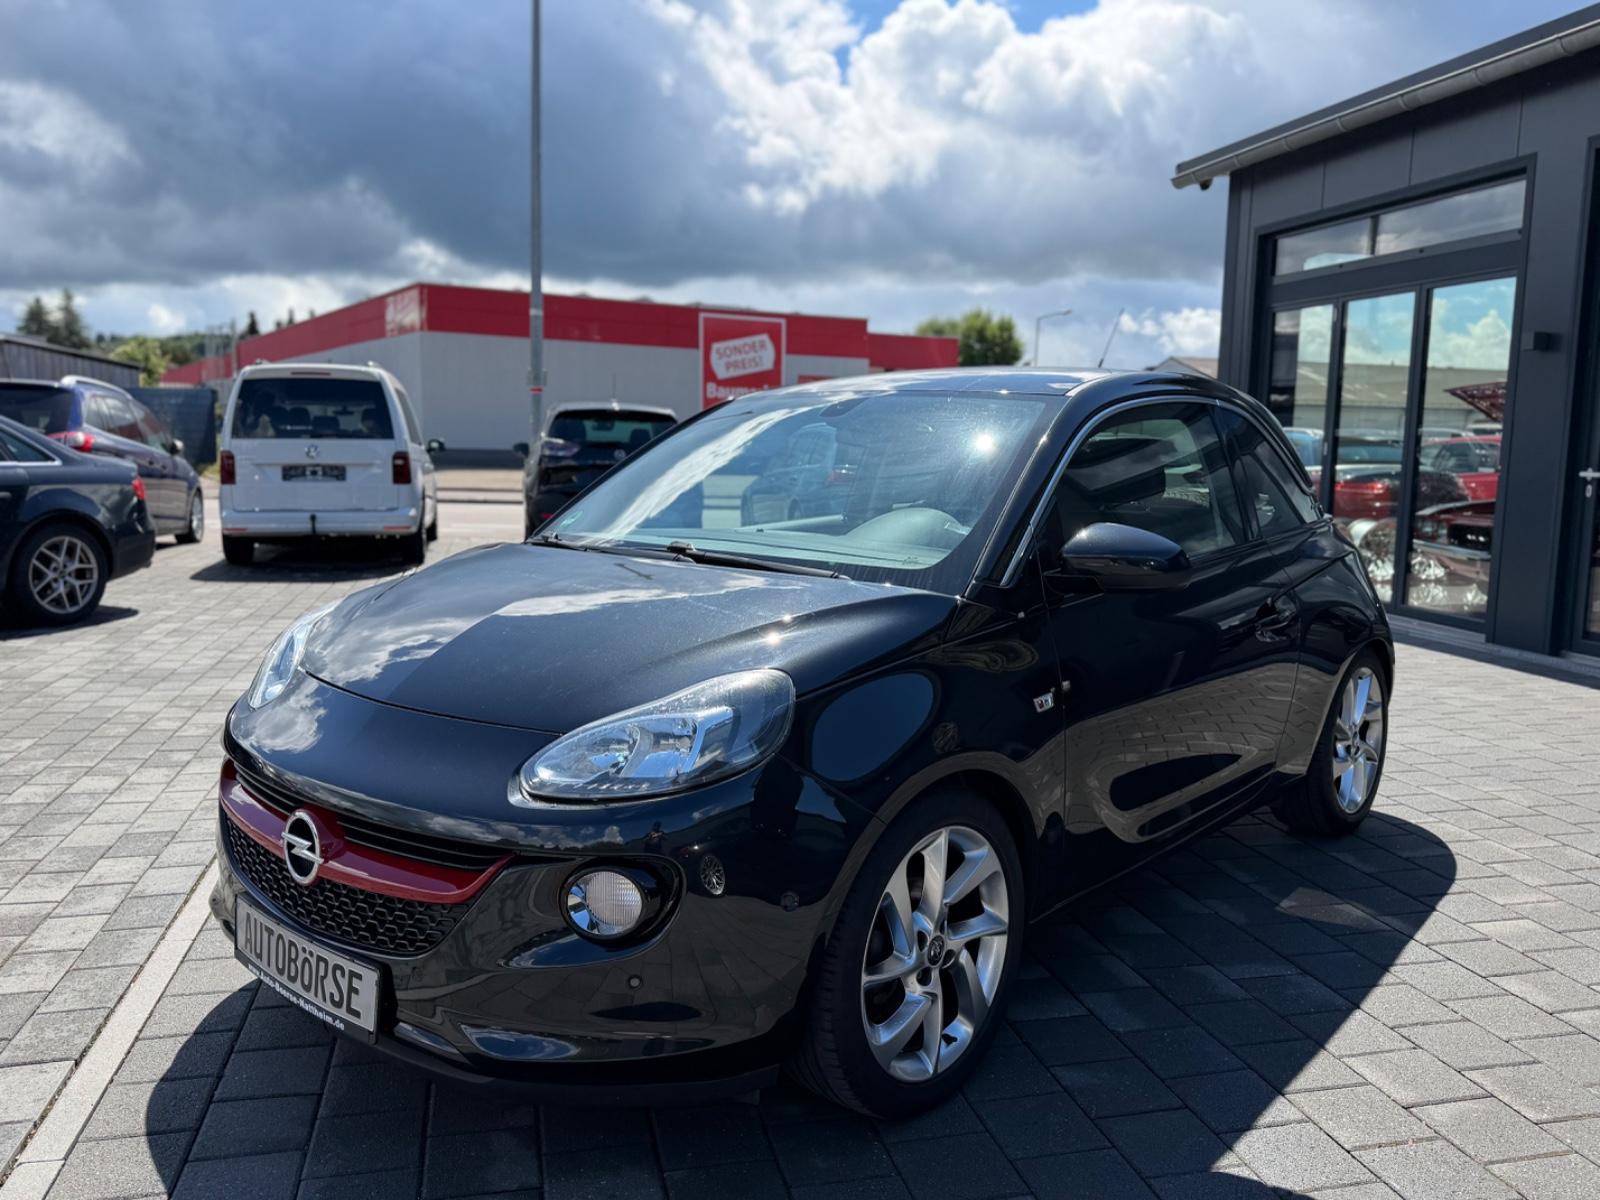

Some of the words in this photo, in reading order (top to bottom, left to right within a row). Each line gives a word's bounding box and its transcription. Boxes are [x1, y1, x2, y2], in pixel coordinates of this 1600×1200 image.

[715, 339, 767, 360] SONDER
[725, 355, 764, 373] PREIS!
[244, 911, 363, 1020] AUTOBÖRSE
